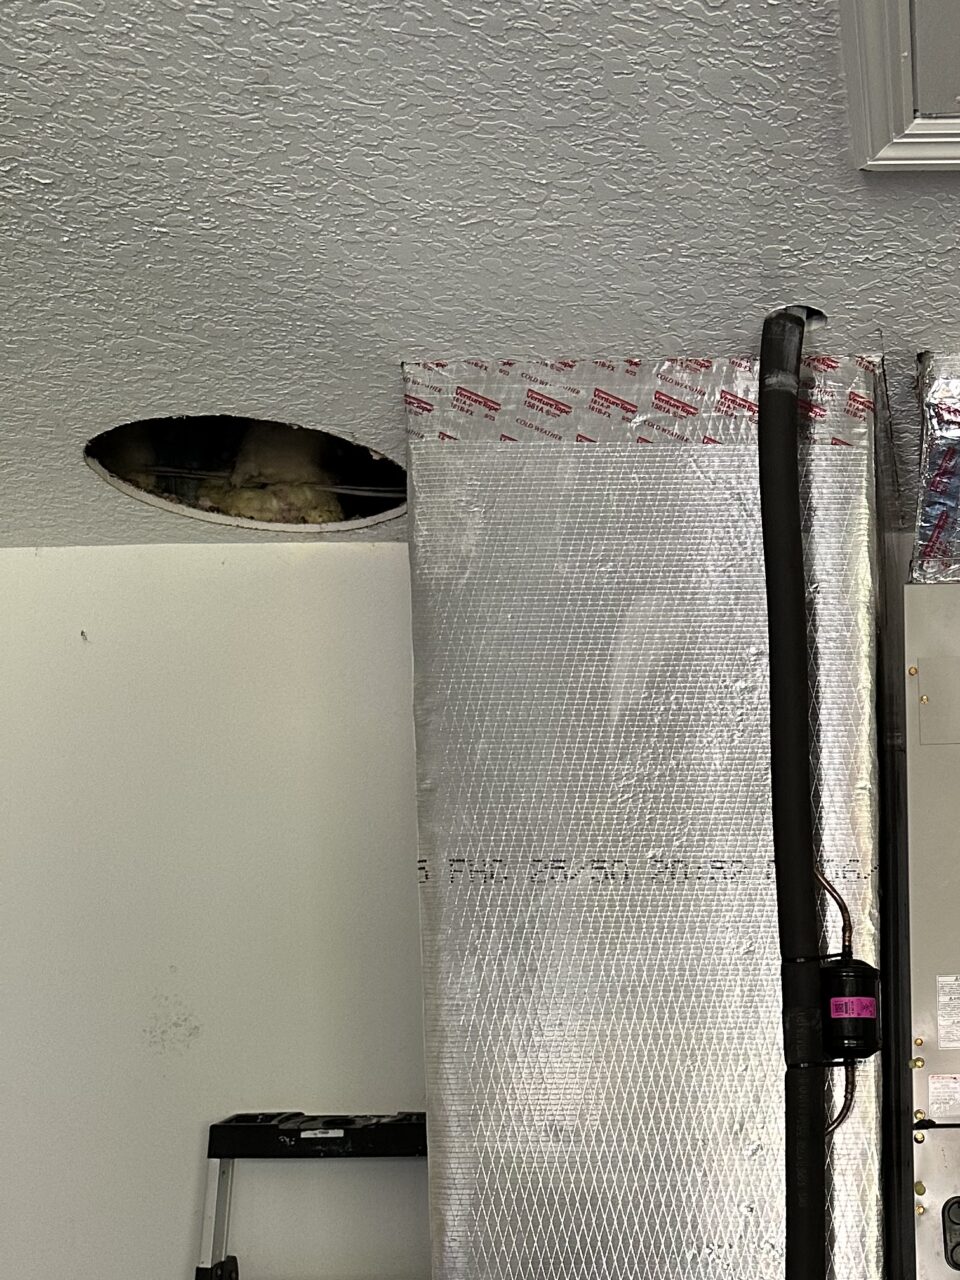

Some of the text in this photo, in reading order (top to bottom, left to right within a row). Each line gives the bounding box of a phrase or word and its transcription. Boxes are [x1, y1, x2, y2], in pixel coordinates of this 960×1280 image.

[527, 391, 573, 416] VentureTape
[594, 390, 638, 415] VentureTape
[654, 393, 699, 418] VentureTape
